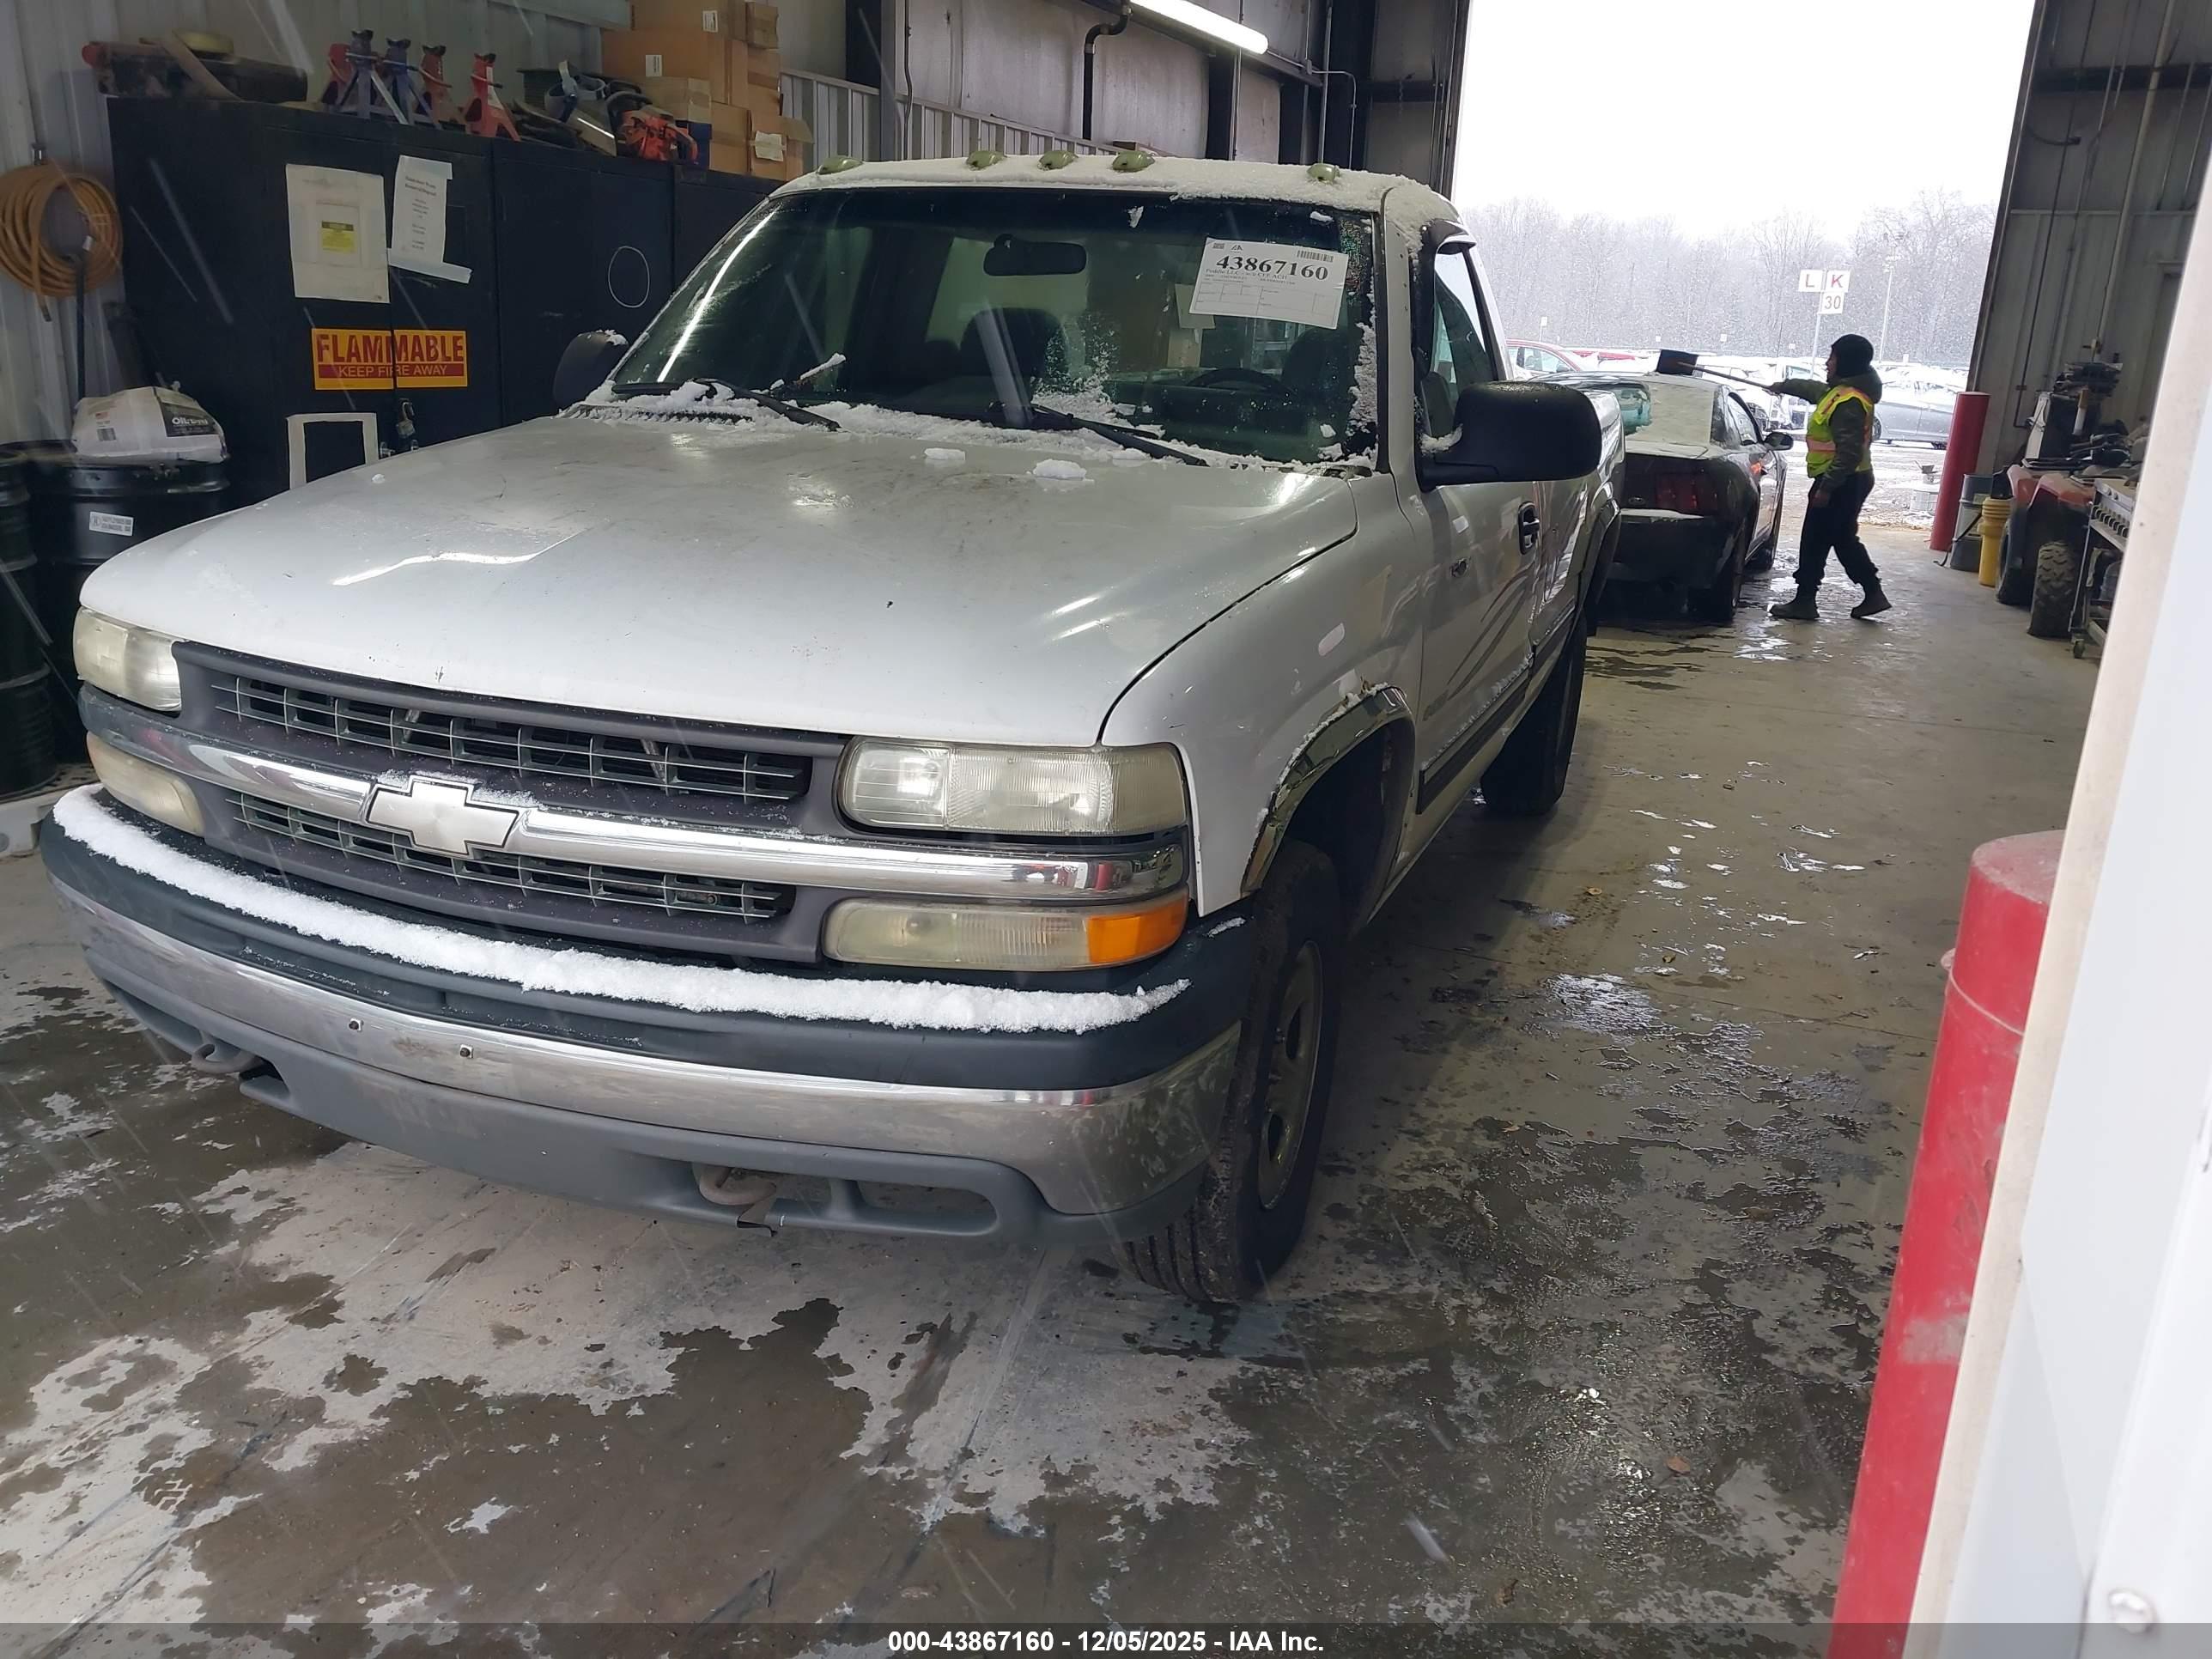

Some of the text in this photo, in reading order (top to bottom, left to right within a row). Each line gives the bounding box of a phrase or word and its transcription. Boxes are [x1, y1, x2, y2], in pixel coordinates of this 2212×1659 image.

[1216, 255, 1328, 281] 43867160
[1805, 274, 1815, 288] L
[1831, 274, 1844, 288] K
[1825, 295, 1842, 310] 30
[316, 333, 465, 363] FLAMMABLE
[338, 364, 447, 378] KEEP FIRE AWAY
